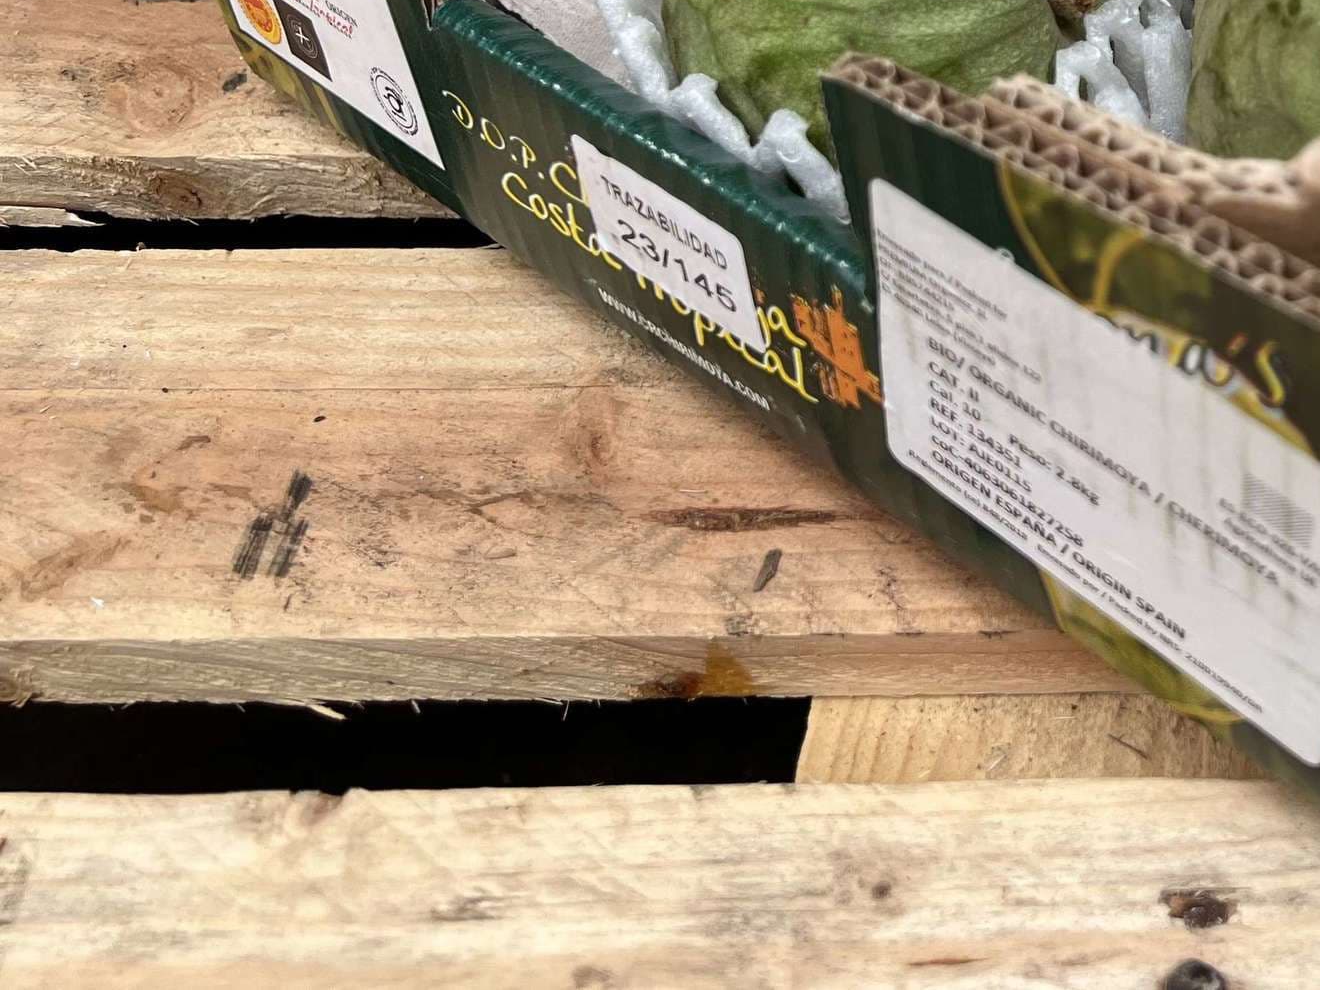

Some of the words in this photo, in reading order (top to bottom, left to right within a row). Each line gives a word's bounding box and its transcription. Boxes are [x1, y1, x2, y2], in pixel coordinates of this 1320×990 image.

[442, 90, 545, 180] D.O.P.
[599, 173, 728, 273] TRAZABILIDAD
[616, 216, 738, 315] 23/145
[930, 413, 964, 447] LOT:
[963, 400, 981, 423] 10
[968, 420, 1021, 470] 134351
[928, 333, 964, 372] BIO/
[968, 361, 1046, 426] ORGANIC
[1049, 416, 1150, 498] CHIRIMOYA
[1167, 497, 1281, 587] CHERIMOYA
[932, 446, 991, 500] ORIGEN
[995, 490, 1056, 547] ESPAÑA
[1072, 548, 1131, 601] ORIGIN
[1135, 594, 1185, 640] SPAIN
